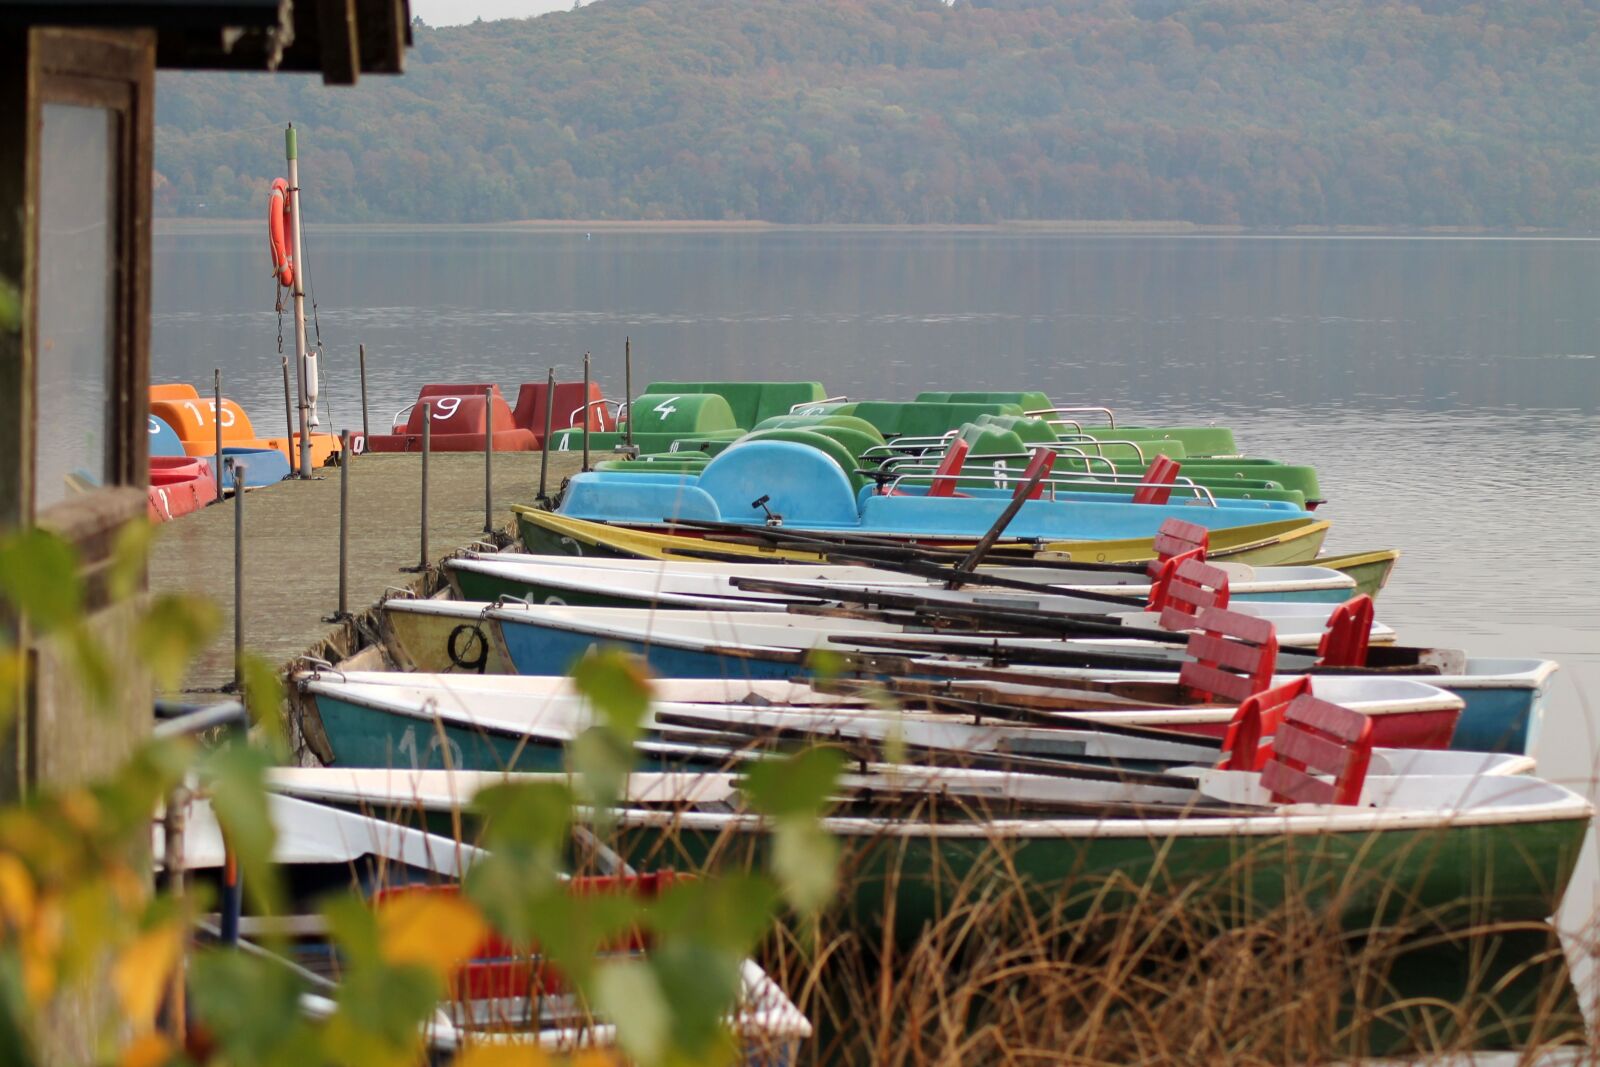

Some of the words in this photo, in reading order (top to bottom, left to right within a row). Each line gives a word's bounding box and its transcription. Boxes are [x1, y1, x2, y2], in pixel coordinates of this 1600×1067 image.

[184, 400, 236, 428] 15
[432, 397, 462, 420] 9
[653, 396, 681, 421] 4
